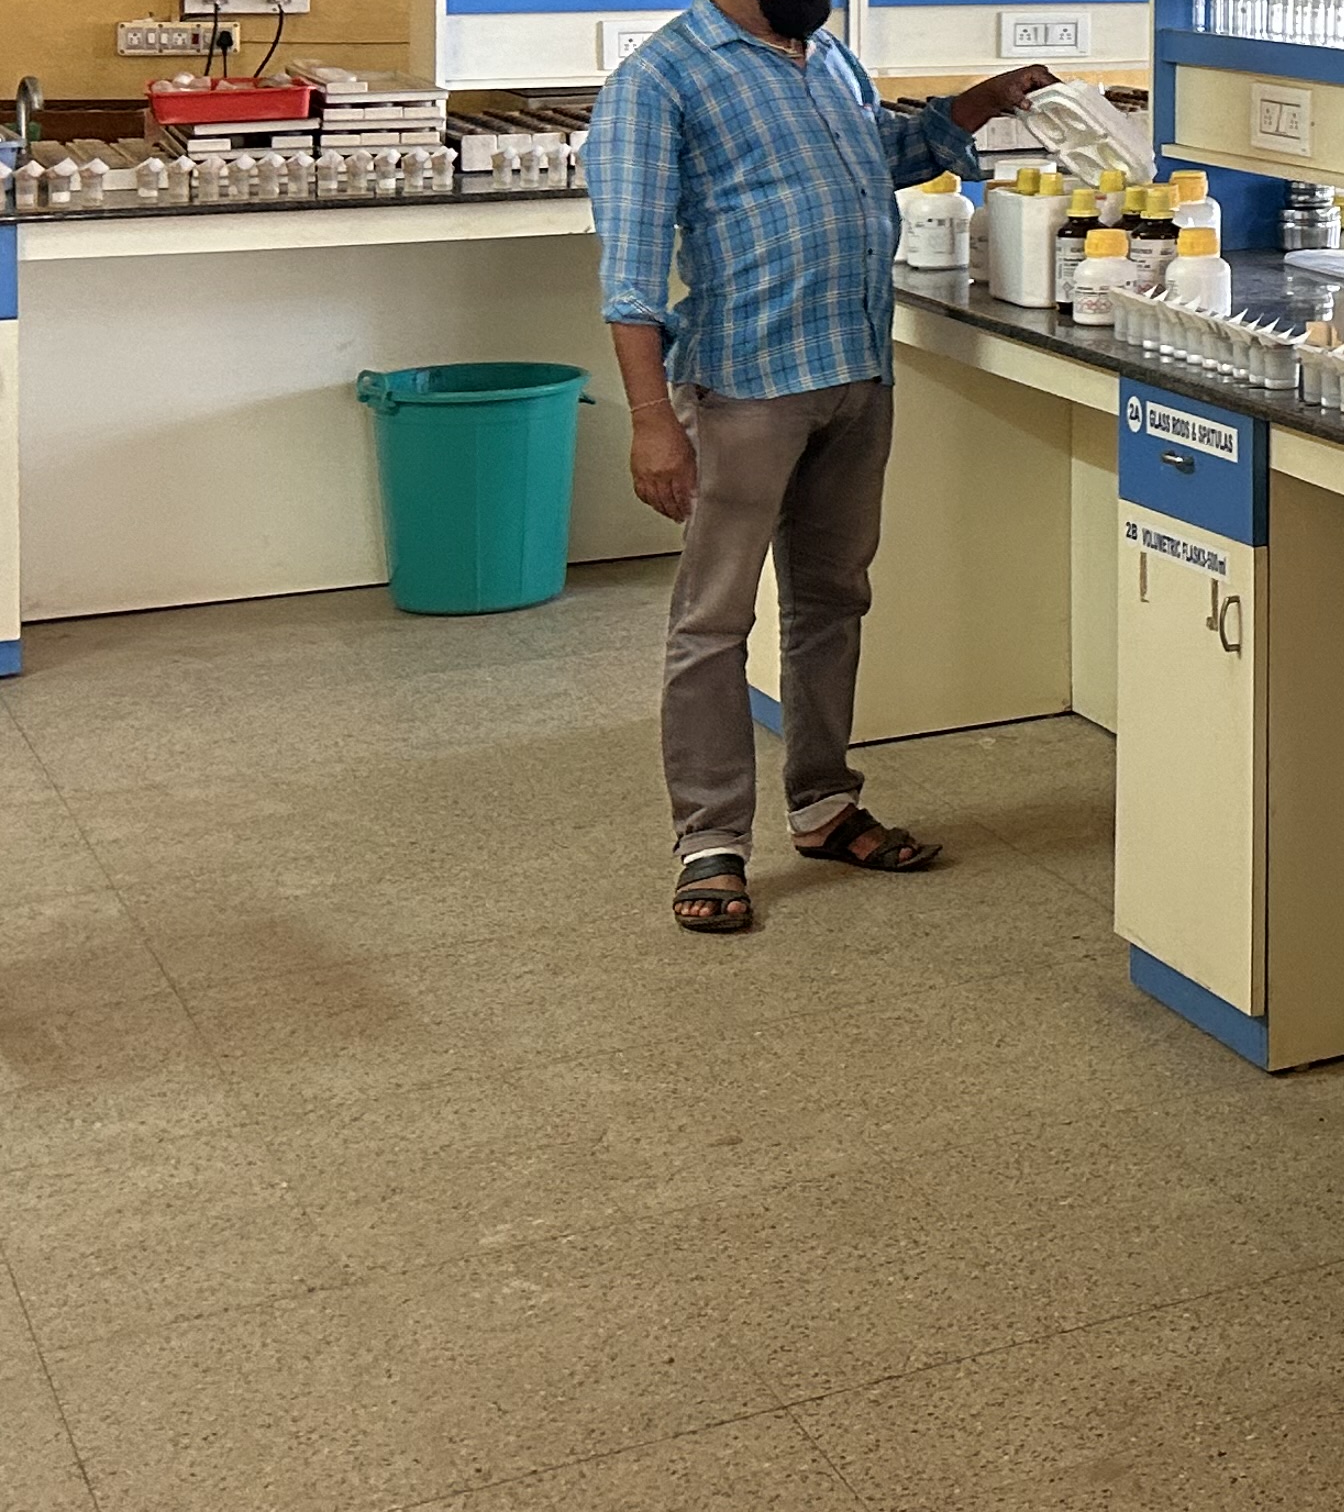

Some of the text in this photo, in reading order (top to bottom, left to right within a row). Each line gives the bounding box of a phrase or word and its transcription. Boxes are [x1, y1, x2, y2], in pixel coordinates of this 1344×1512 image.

[1129, 403, 1140, 422] 2A
[1150, 409, 1170, 433] GLASS
[1171, 416, 1190, 439] RODS
[1198, 424, 1233, 453] SPATULAS
[1126, 521, 1138, 541] 2B
[1141, 528, 1181, 558] VOLUMETRIC
